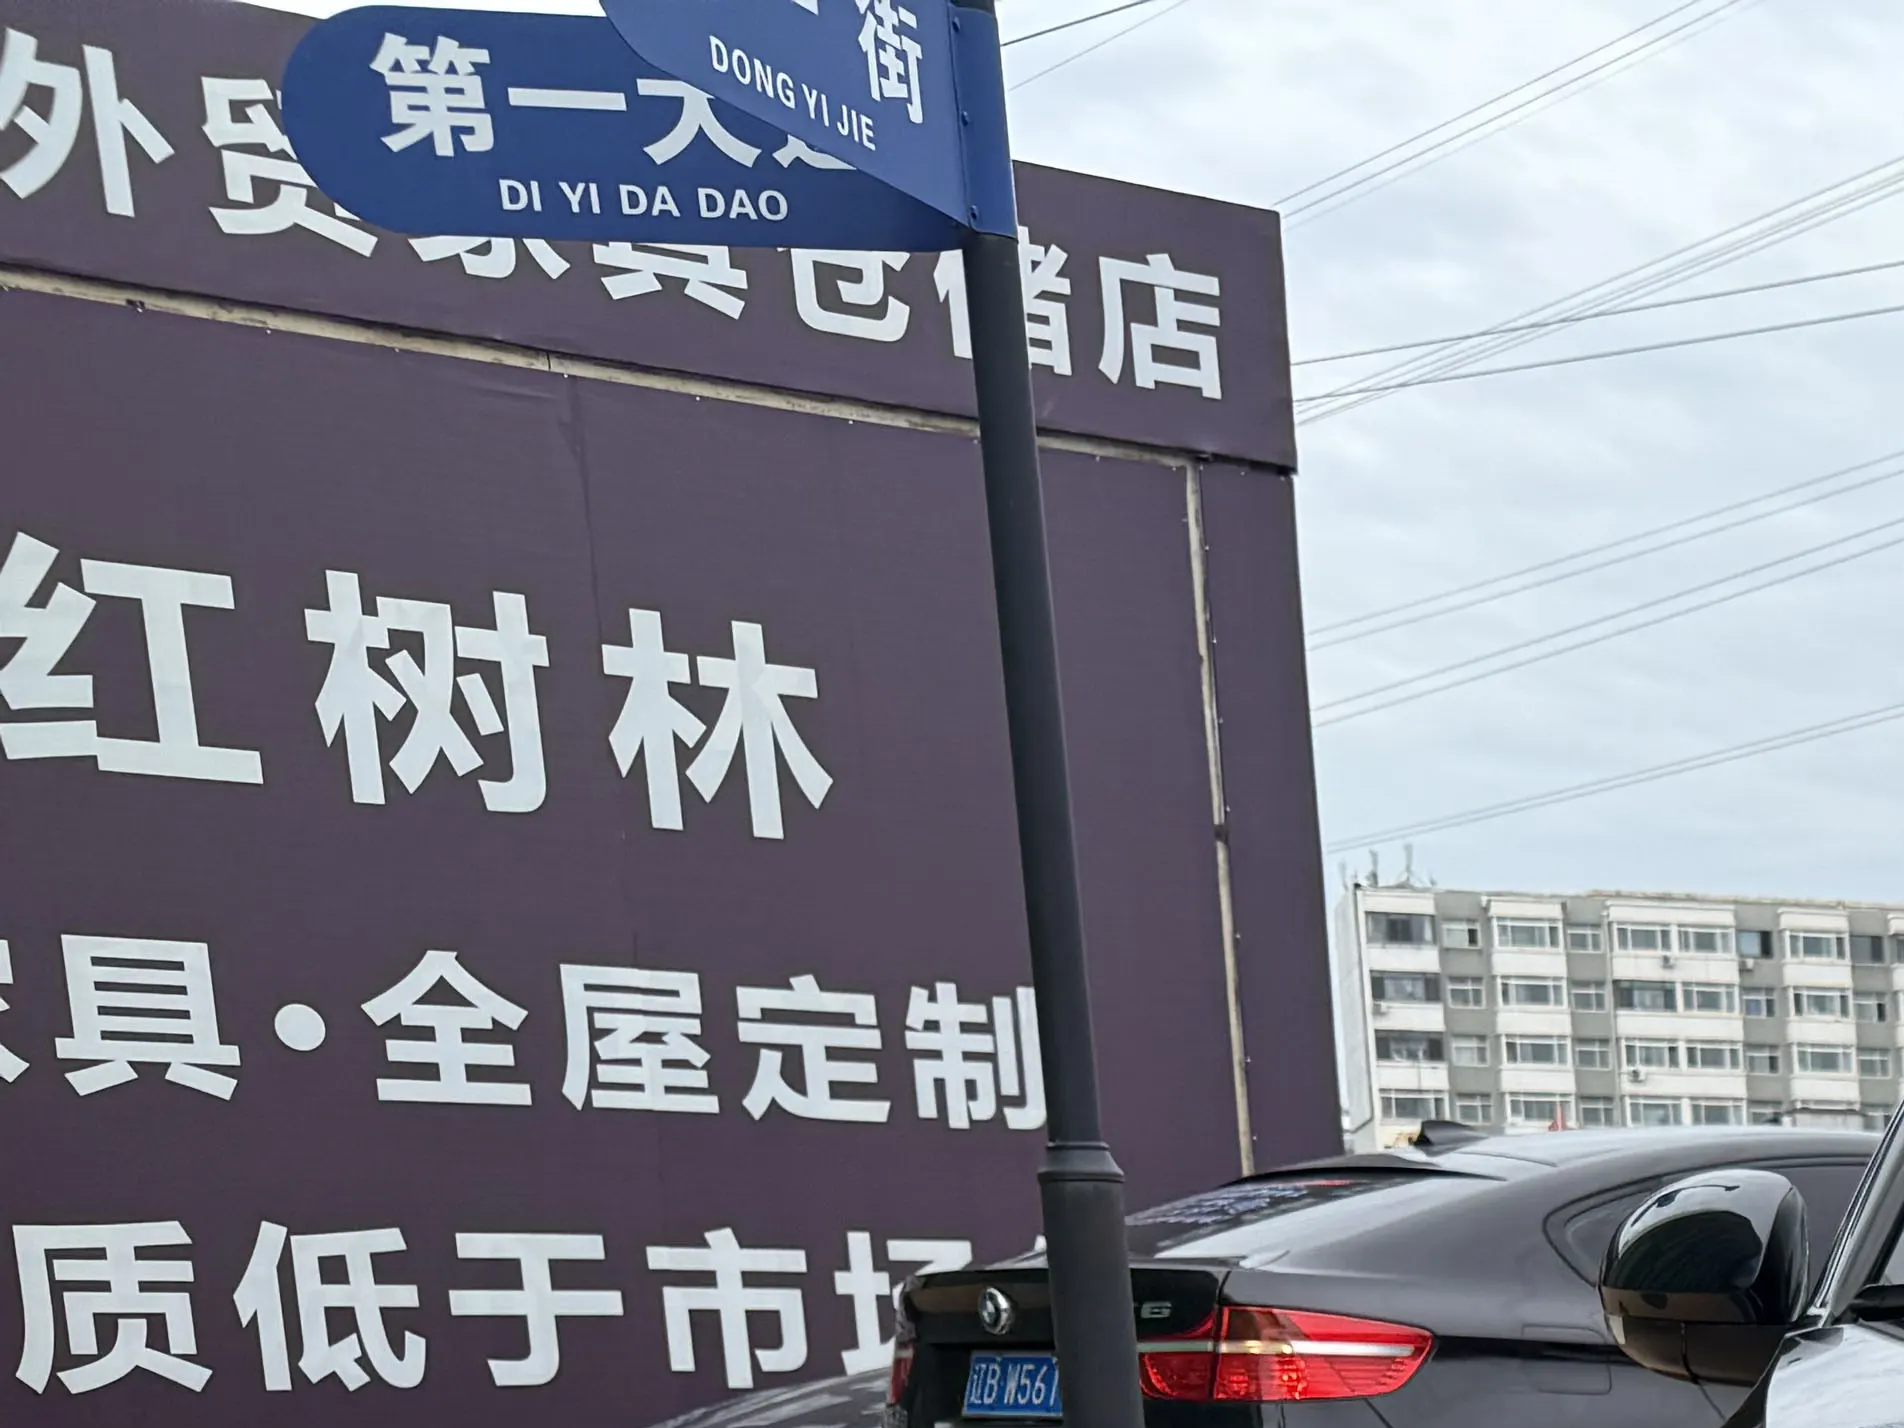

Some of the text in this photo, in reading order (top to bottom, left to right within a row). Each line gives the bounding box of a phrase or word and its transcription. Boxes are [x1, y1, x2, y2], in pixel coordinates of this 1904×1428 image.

[369, 32, 857, 170] 第一大
[708, 35, 876, 152] DONG YI JIE
[499, 178, 788, 221] DI YI DA DAO
[0, 532, 833, 840] 红树林
[0, 933, 1047, 1131] 具·全屋定制
